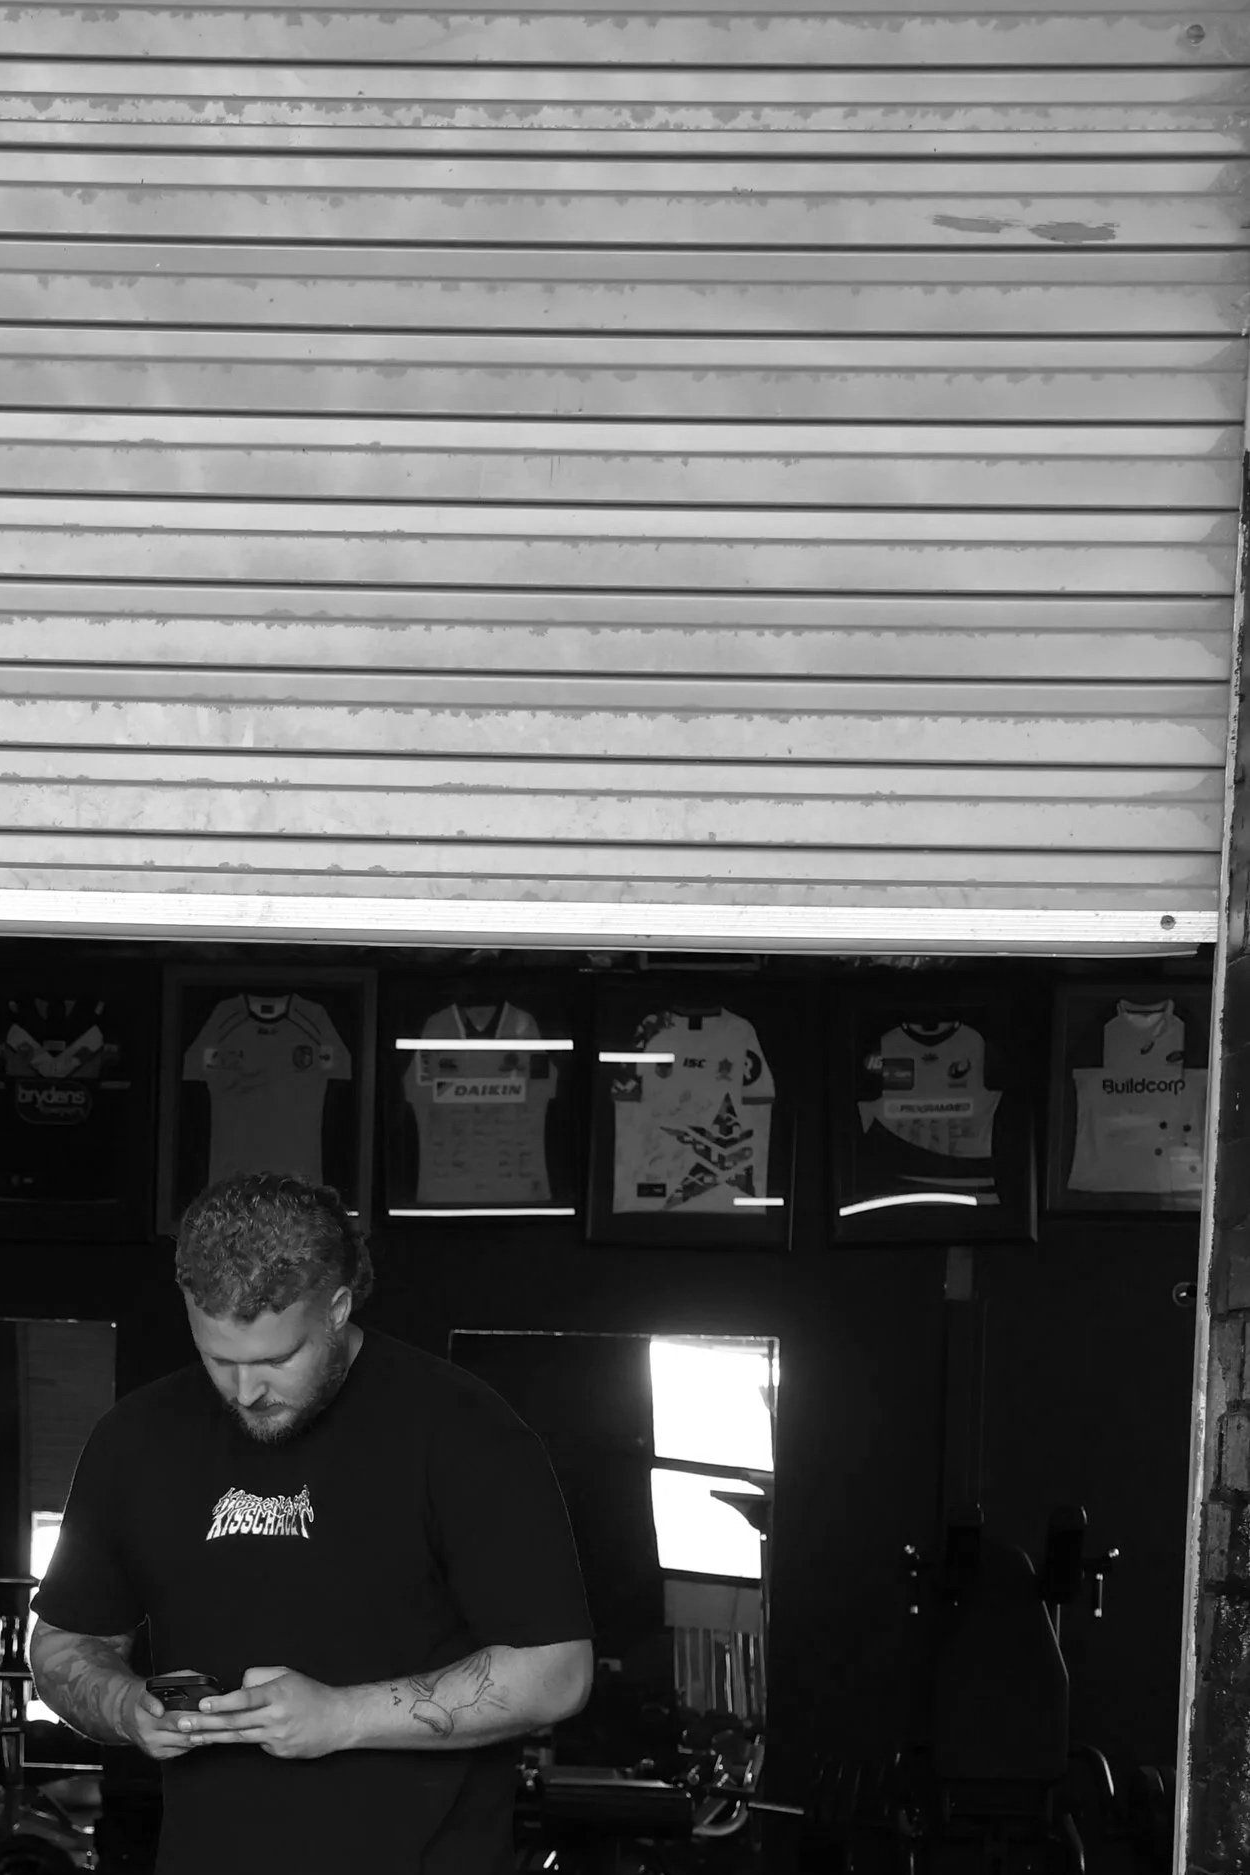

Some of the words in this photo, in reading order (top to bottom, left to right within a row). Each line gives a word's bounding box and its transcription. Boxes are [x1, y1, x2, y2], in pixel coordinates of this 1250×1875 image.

[454, 1085, 521, 1096] DAIKIN
[1102, 1078, 1185, 1095] Buildcorp
[18, 1084, 85, 1107] brydens
